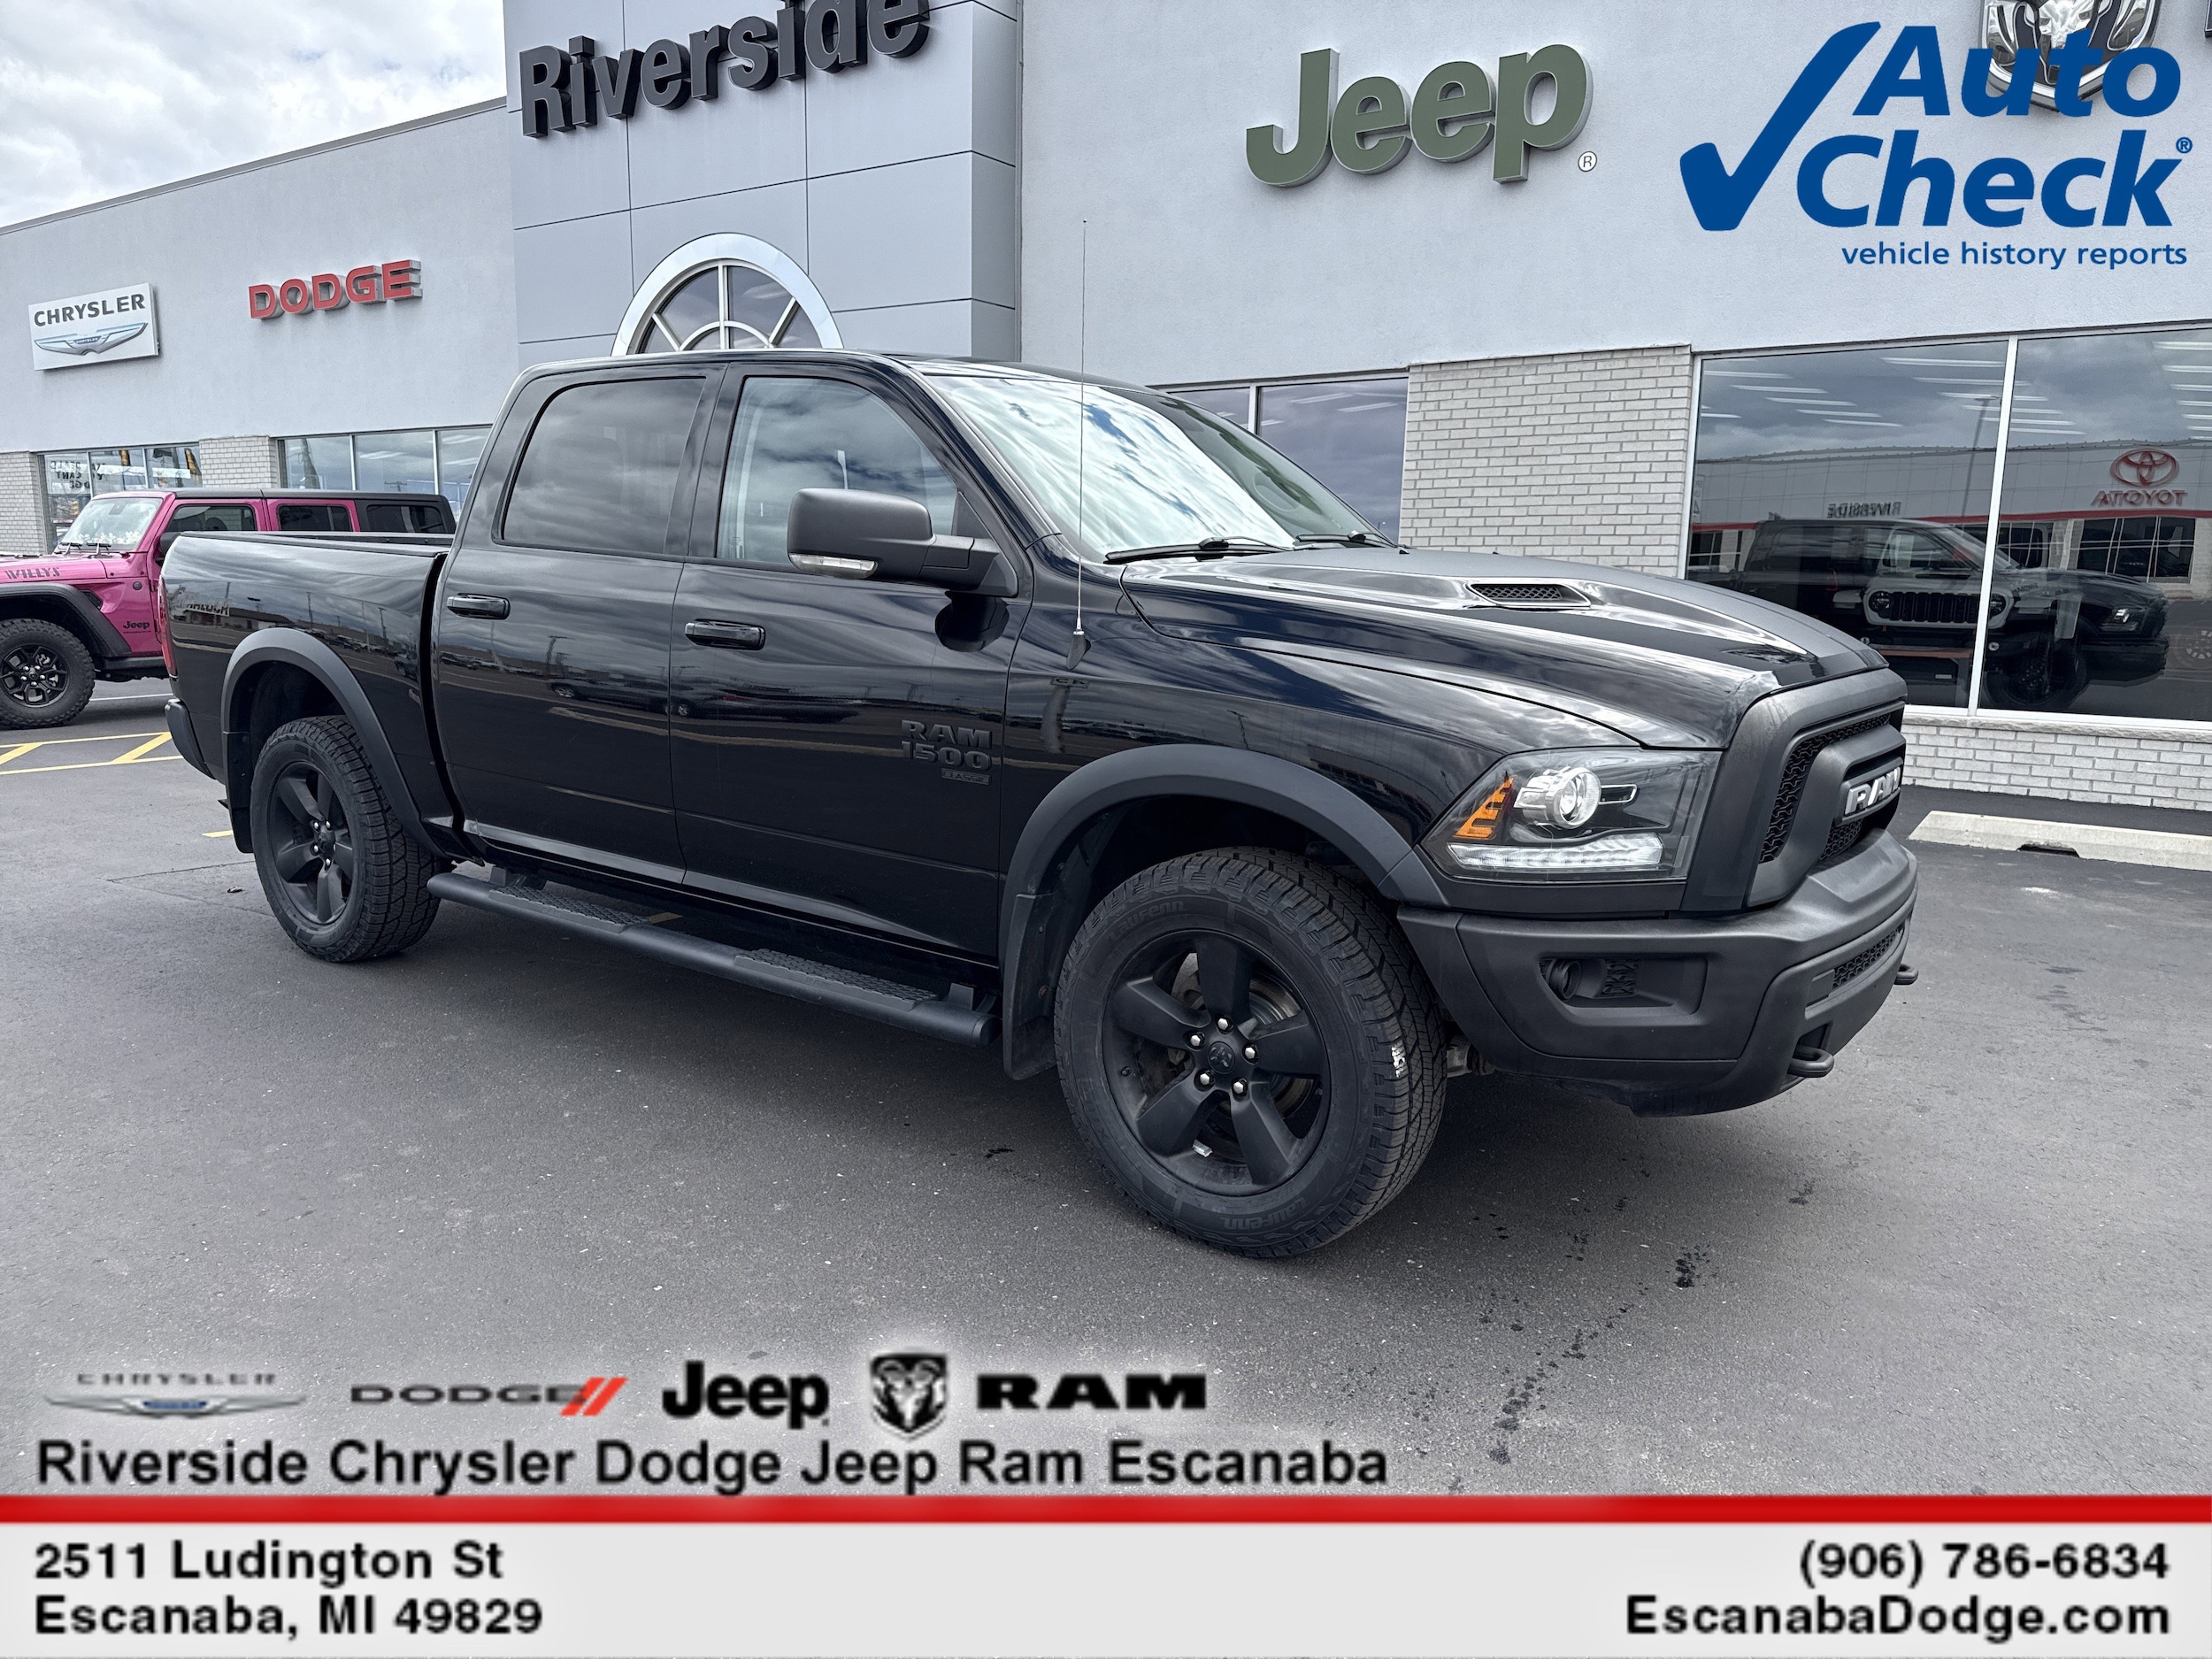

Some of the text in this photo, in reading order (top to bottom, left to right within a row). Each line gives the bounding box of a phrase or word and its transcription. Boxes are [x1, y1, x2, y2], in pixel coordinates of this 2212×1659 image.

[519, 0, 930, 137] Riverside
[1246, 44, 1594, 184] Jeep
[249, 259, 422, 319] DODGE
[34, 294, 146, 326] CHRYSLER
[4, 567, 60, 580] WILLYS
[901, 719, 993, 749] RAM
[901, 740, 992, 772] 1500
[1845, 766, 1901, 815] RAM
